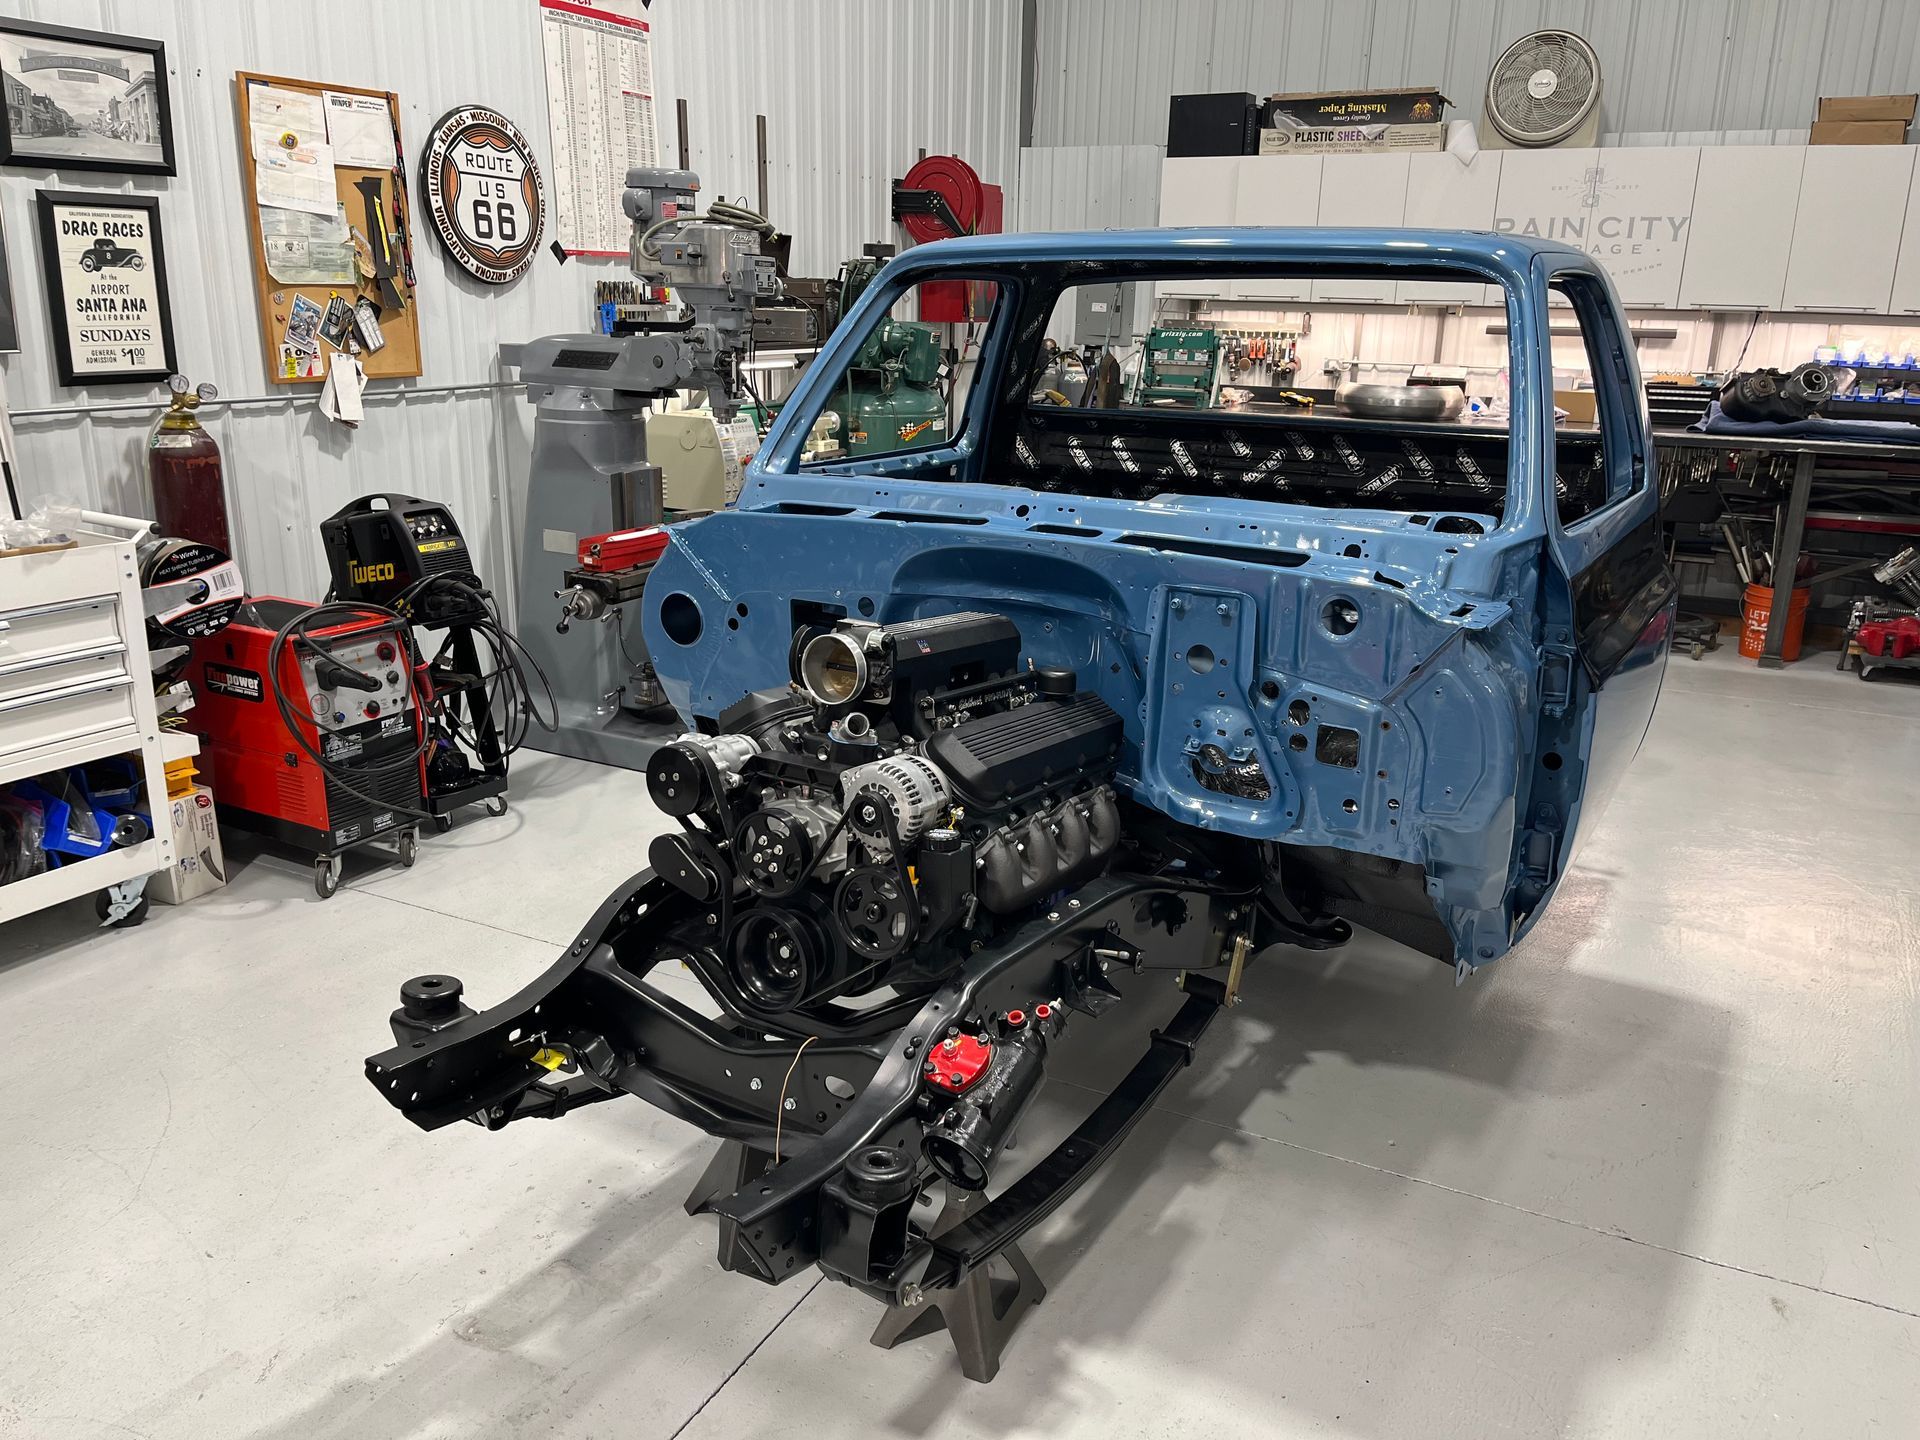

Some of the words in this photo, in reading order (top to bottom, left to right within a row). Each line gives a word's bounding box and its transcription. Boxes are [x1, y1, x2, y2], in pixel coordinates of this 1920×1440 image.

[583, 17, 594, 26] DRILL
[594, 19, 605, 28] SIZES
[1318, 103, 1346, 114] Paper
[1347, 103, 1387, 114] Masking
[470, 111, 509, 130] MISSOURI
[438, 116, 467, 144] KANSAS
[1295, 131, 1334, 142] PLASTIC
[465, 152, 514, 173] ROUTE
[512, 128, 528, 150] NEW
[527, 149, 544, 190] MEXICO
[431, 149, 443, 197] ILLINOIS
[472, 199, 517, 242] 66
[533, 199, 547, 254] OKLAHOMA
[1598, 215, 1690, 242] CITY
[62, 220, 98, 236] DRAG
[102, 222, 144, 238] RACES
[434, 204, 471, 265] CALIFORNIA
[106, 252, 112, 260] 8
[474, 263, 508, 281] ARIZONA
[511, 258, 529, 278] TEXAS
[109, 273, 118, 281] the
[91, 284, 129, 295] AIRPORT
[76, 298, 117, 313] SANTA
[121, 298, 147, 313] ANA
[85, 313, 141, 321] CALIFORNIA
[80, 329, 151, 342] SUNDAYS
[1161, 330, 1204, 338] grizzly.com
[91, 349, 117, 357] GENERAL
[1380, 467, 1399, 483] MAT
[179, 549, 199, 560] Wirefy
[159, 567, 171, 575] HEAT
[171, 562, 188, 571] SHRINK
[188, 556, 206, 566] TUBING
[348, 560, 395, 588] TWECO
[1749, 609, 1769, 621] LET'
